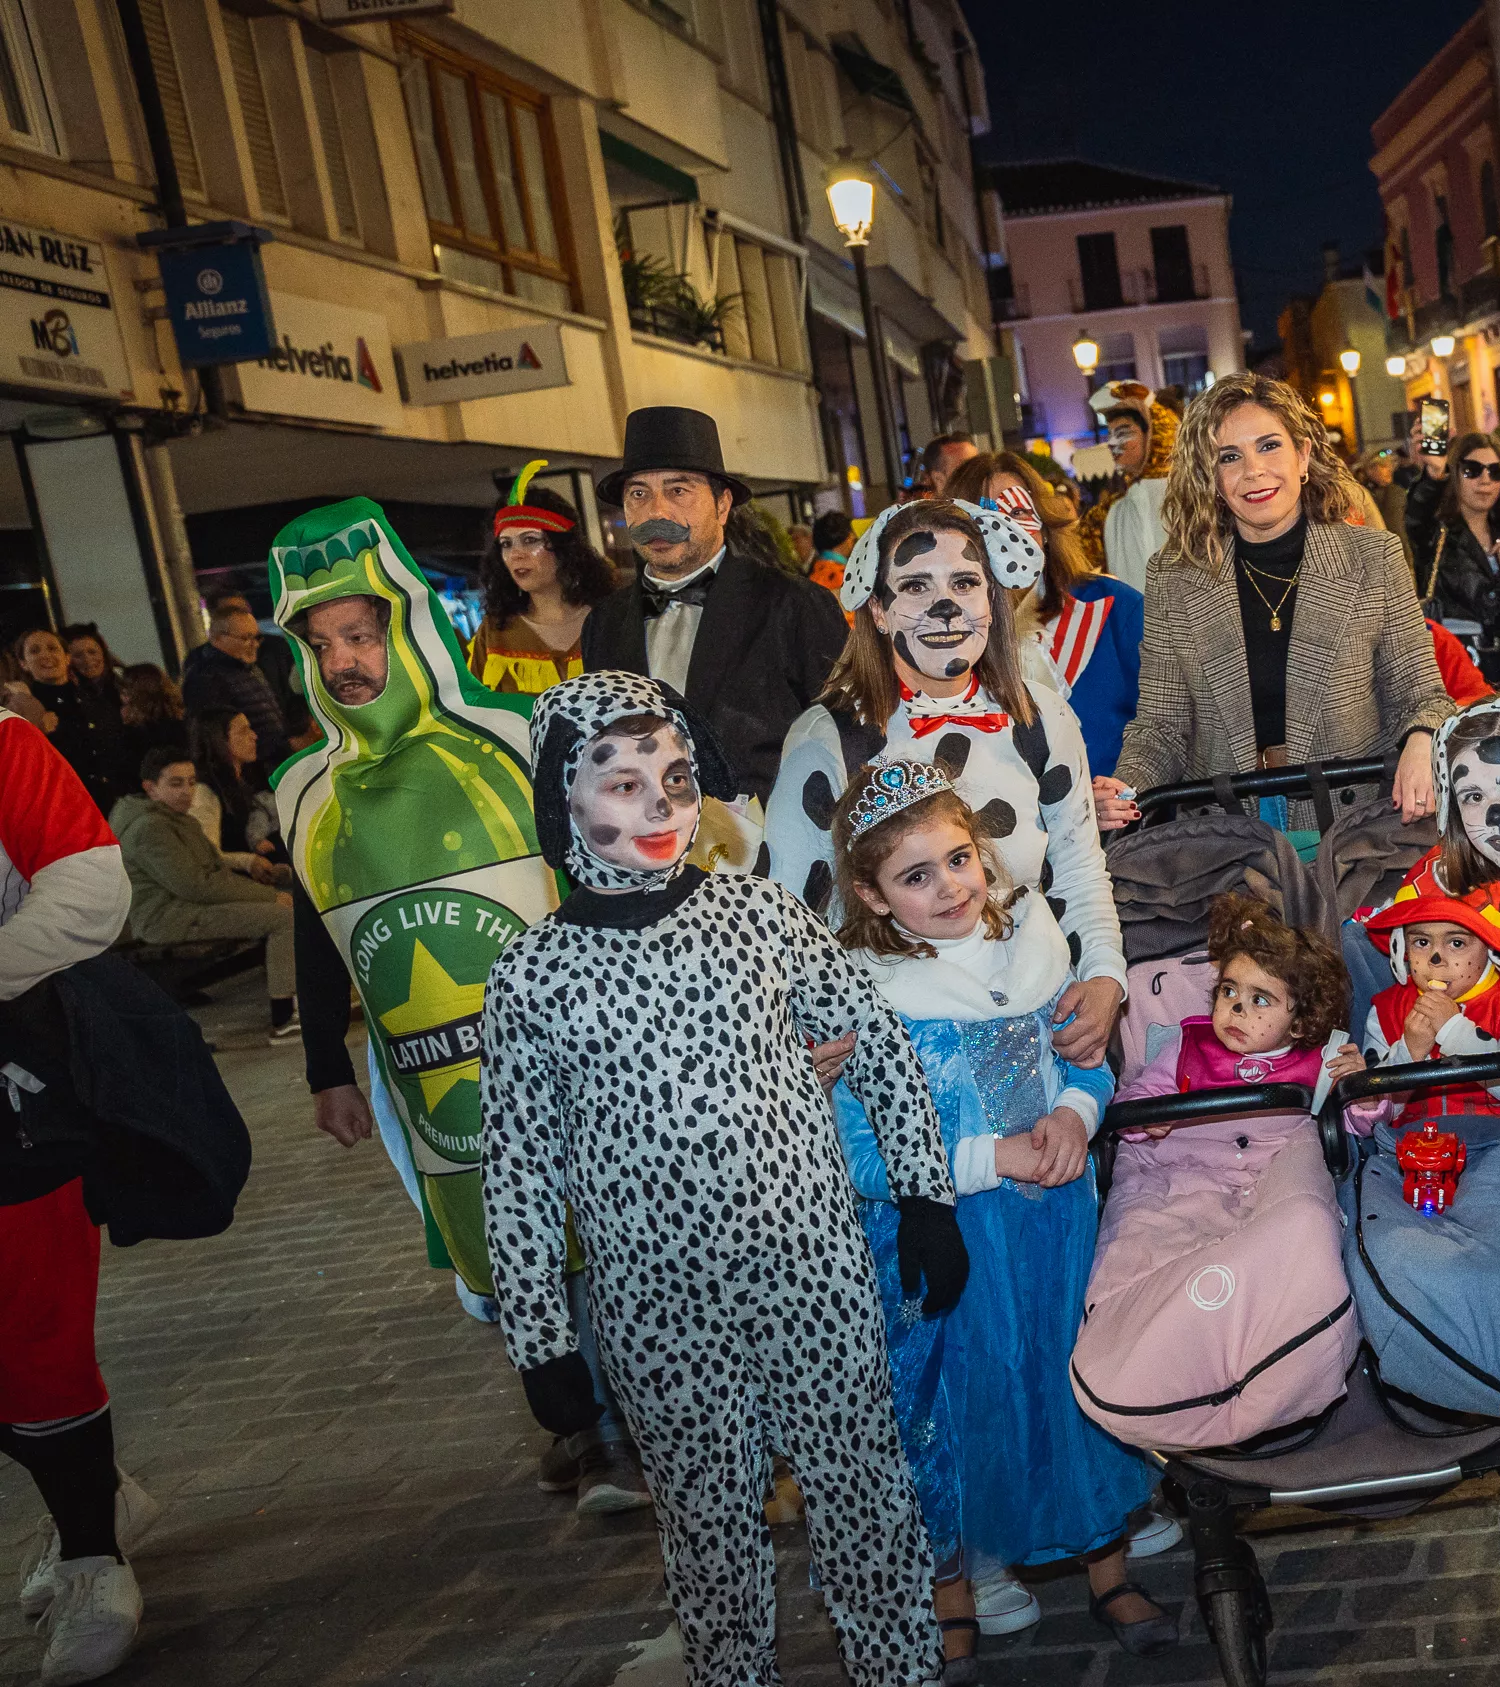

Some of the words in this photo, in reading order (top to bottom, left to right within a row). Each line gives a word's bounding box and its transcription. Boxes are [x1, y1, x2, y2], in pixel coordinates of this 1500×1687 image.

[184, 299, 249, 320] Allianz
[423, 352, 514, 382] helvetia
[357, 918, 392, 985] LONG
[399, 901, 461, 930] LIVE
[390, 1032, 452, 1069] LATIN
[456, 1021, 482, 1053] B
[418, 1113, 482, 1152] PREMIUM
